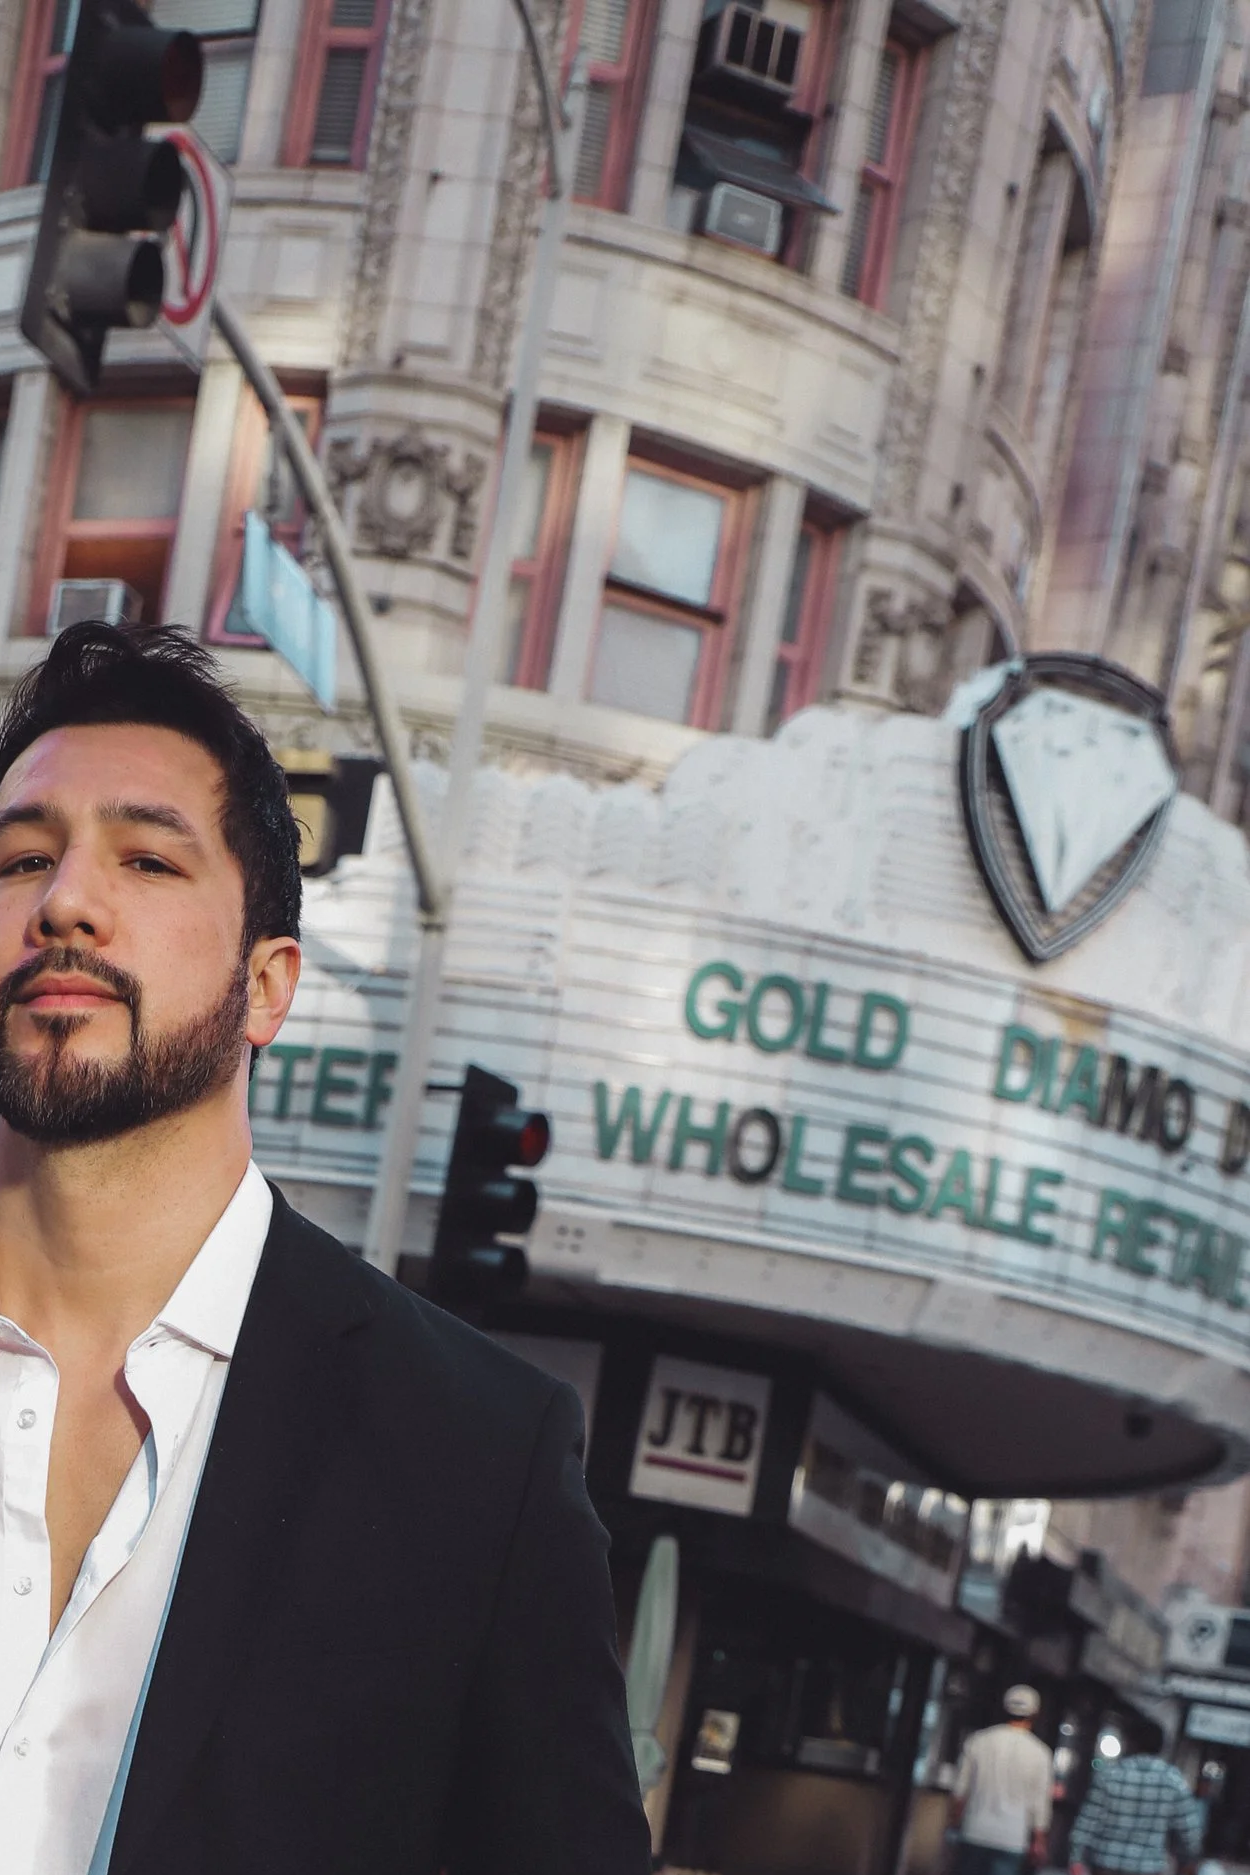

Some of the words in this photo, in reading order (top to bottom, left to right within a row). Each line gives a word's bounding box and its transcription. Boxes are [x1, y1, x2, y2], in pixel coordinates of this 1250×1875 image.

[684, 959, 910, 1071] GOLD
[992, 1023, 1195, 1153] DIAMO
[593, 1080, 1066, 1246] WHOLESALE
[647, 1385, 759, 1464] JTB
